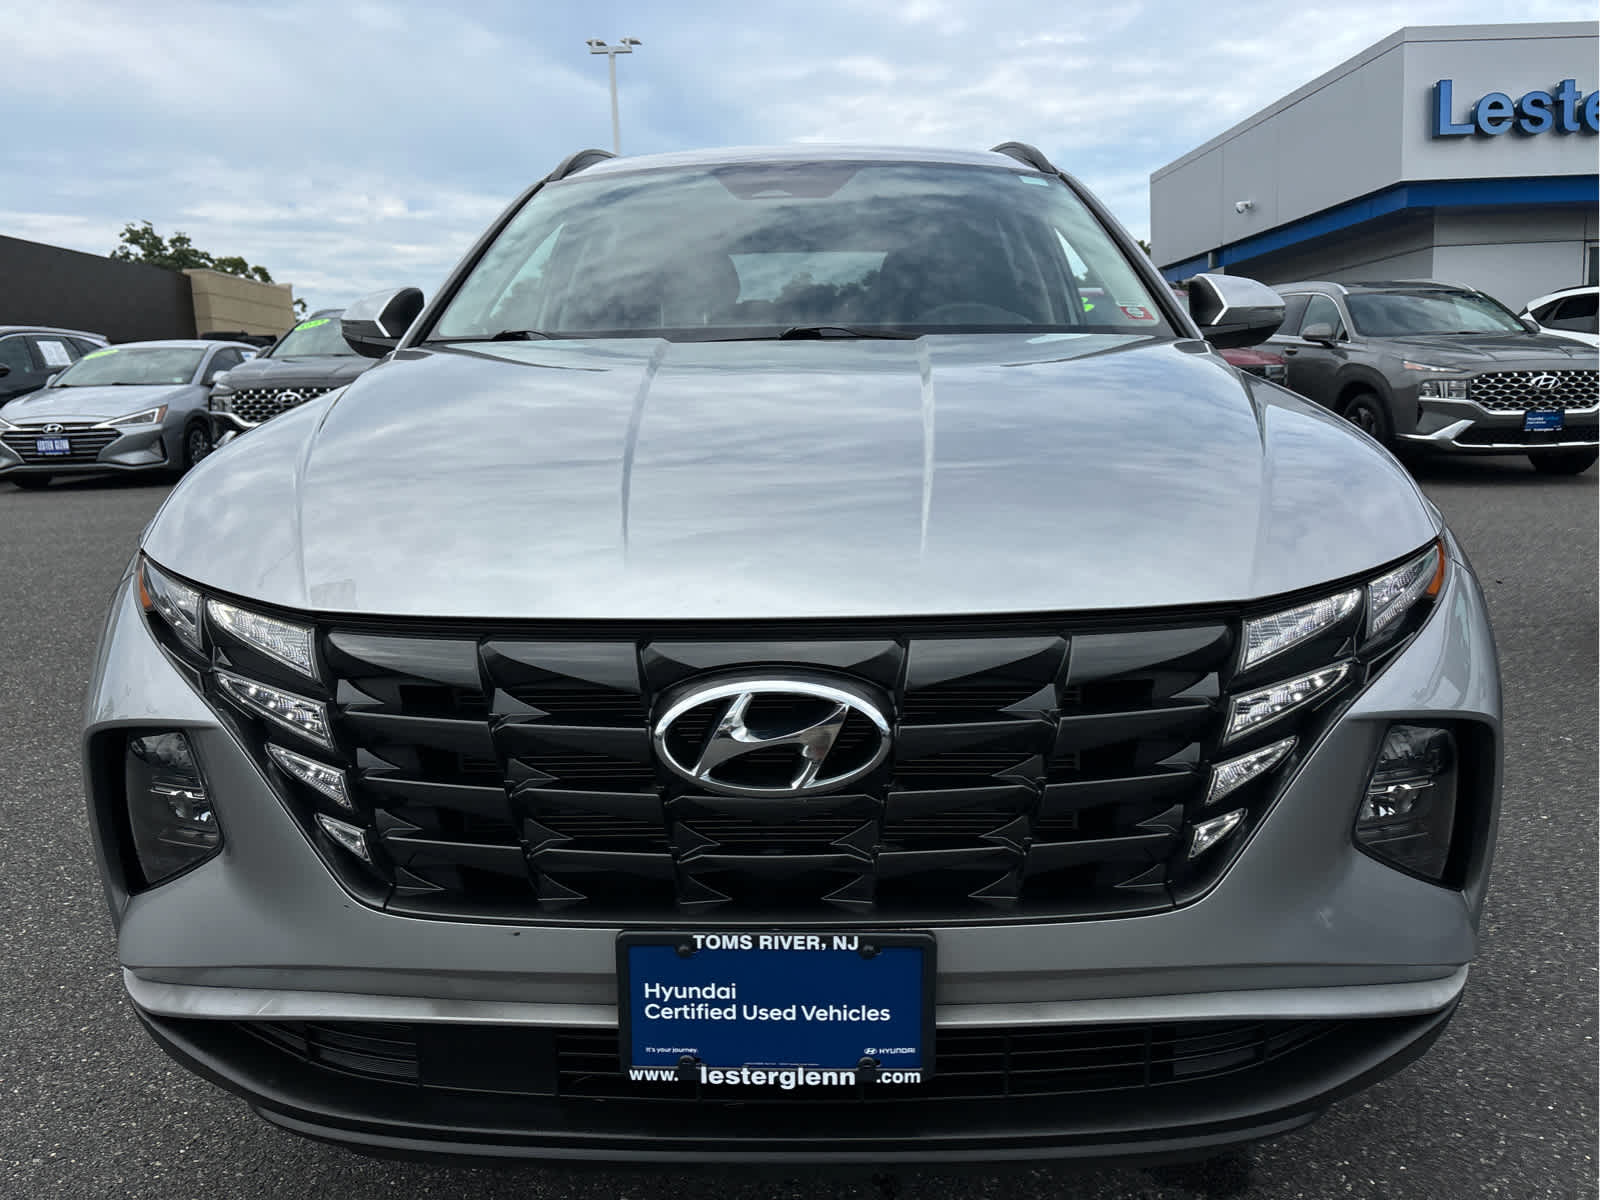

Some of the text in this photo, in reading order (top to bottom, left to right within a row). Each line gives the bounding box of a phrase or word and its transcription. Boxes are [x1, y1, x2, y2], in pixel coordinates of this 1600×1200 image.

[693, 935, 859, 951] TOMS RIVER, NJ
[644, 983, 737, 1002] Hyundai
[644, 1003, 891, 1021] Certified Used Vehicles
[629, 1066, 921, 1089] www. lesterglenn .com
